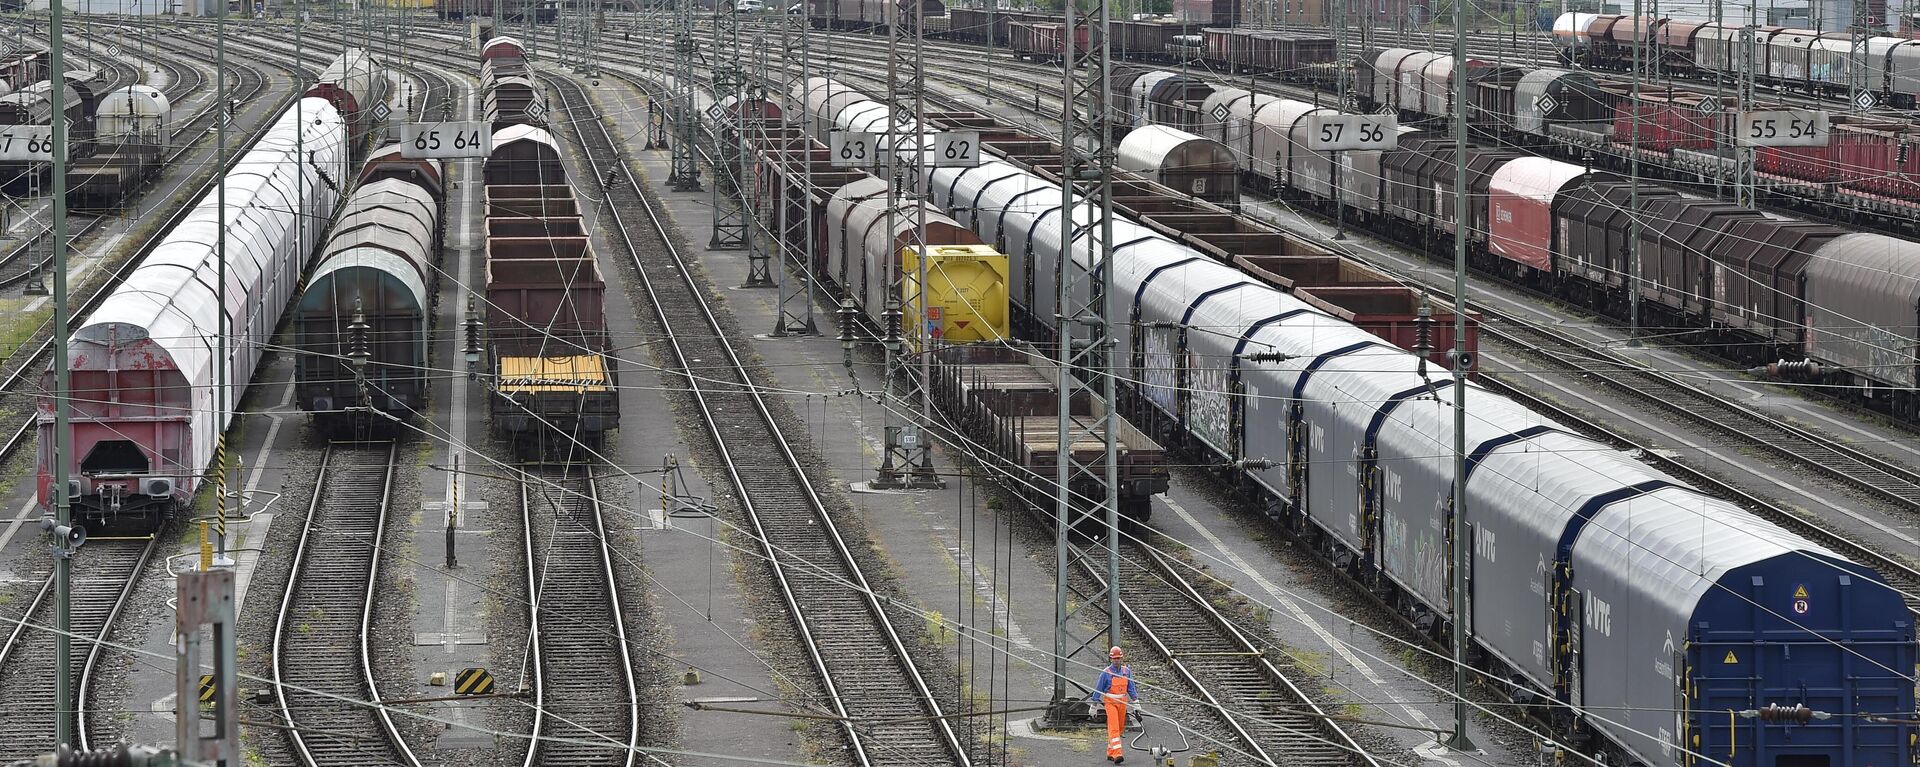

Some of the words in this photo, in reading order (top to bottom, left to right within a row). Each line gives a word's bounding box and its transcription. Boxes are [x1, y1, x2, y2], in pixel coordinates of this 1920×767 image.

[1320, 123, 1344, 142] 57
[1360, 123, 1384, 142] 56
[1750, 120, 1777, 138] 55
[1789, 120, 1816, 138] 54
[0, 134, 13, 153] 7
[27, 134, 52, 153] 66
[414, 131, 440, 150] 65
[454, 130, 480, 149] 64
[840, 141, 866, 160] 63
[945, 140, 970, 159] 62
[1482, 527, 1496, 563] VTG
[1593, 596, 1611, 638] VTG
